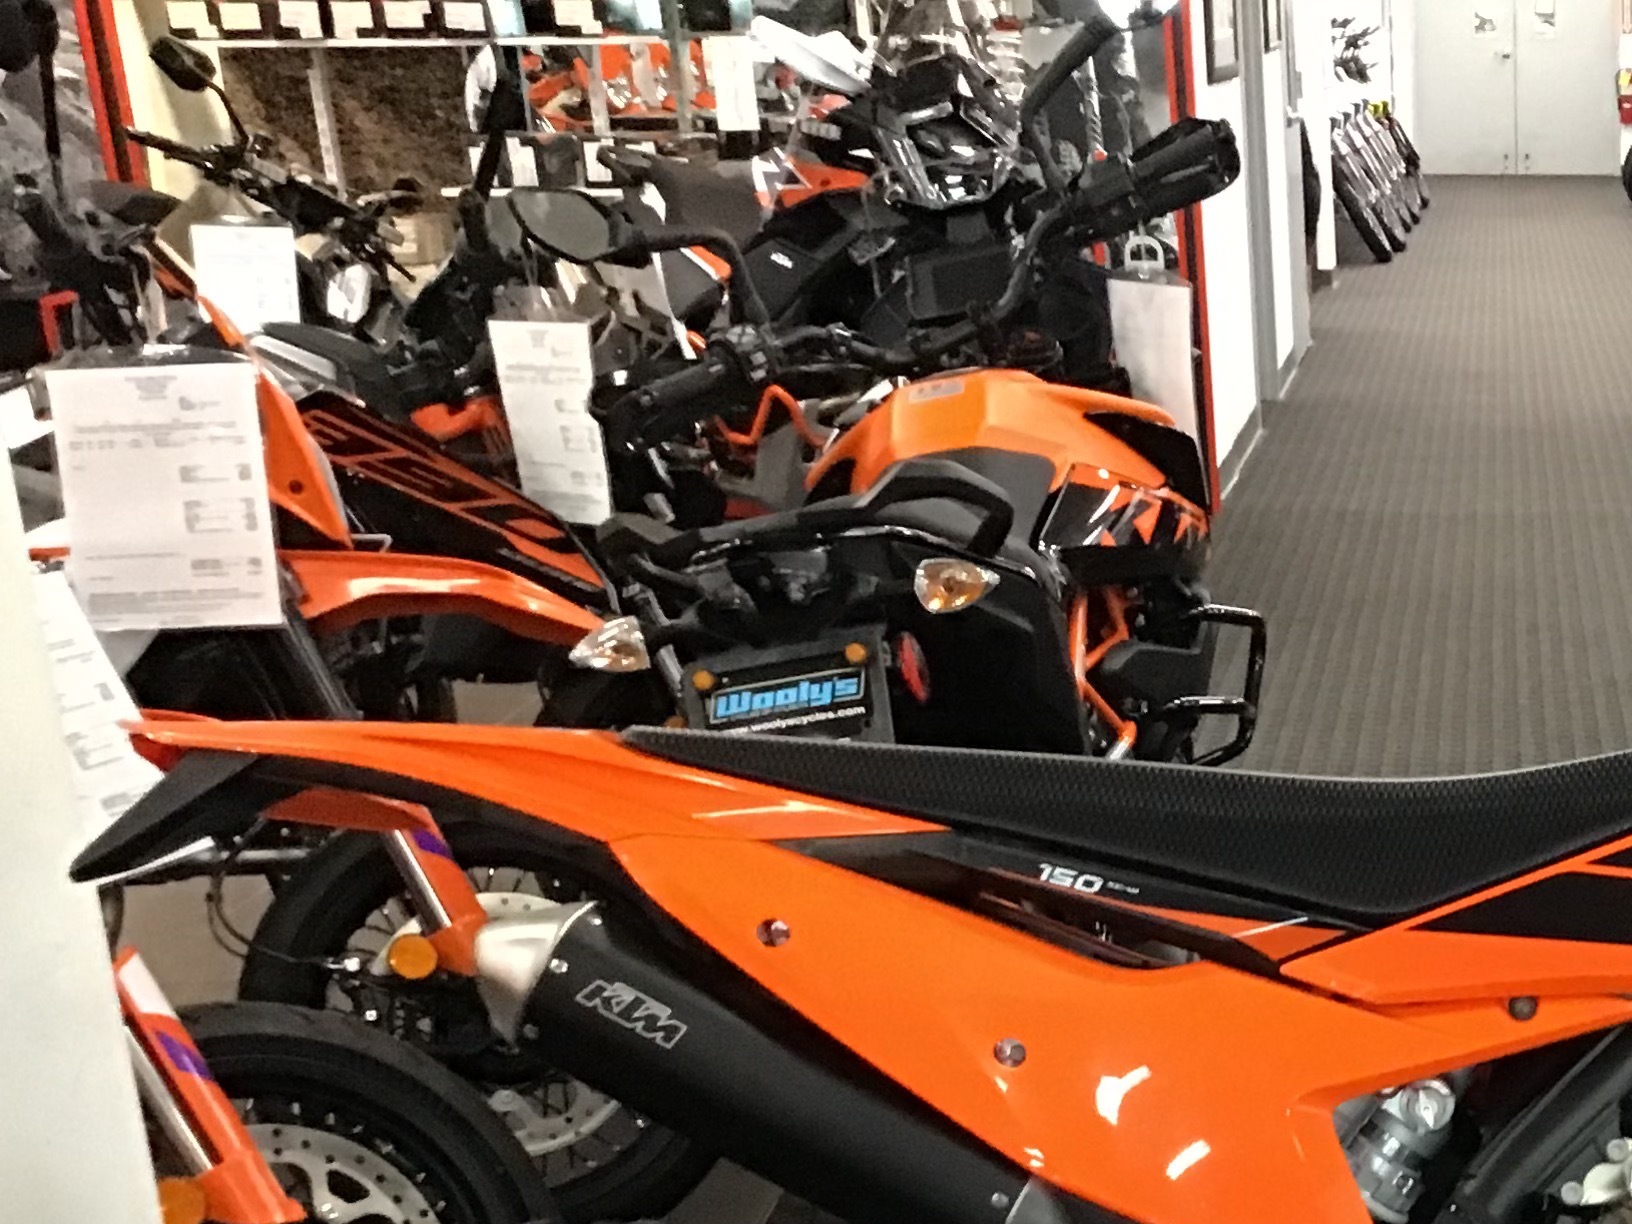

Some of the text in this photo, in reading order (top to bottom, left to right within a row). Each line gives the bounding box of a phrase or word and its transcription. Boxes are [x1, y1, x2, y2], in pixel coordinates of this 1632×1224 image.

[716, 676, 858, 719] Wooly's
[1038, 862, 1105, 894] 150
[574, 978, 688, 1050] KTM
